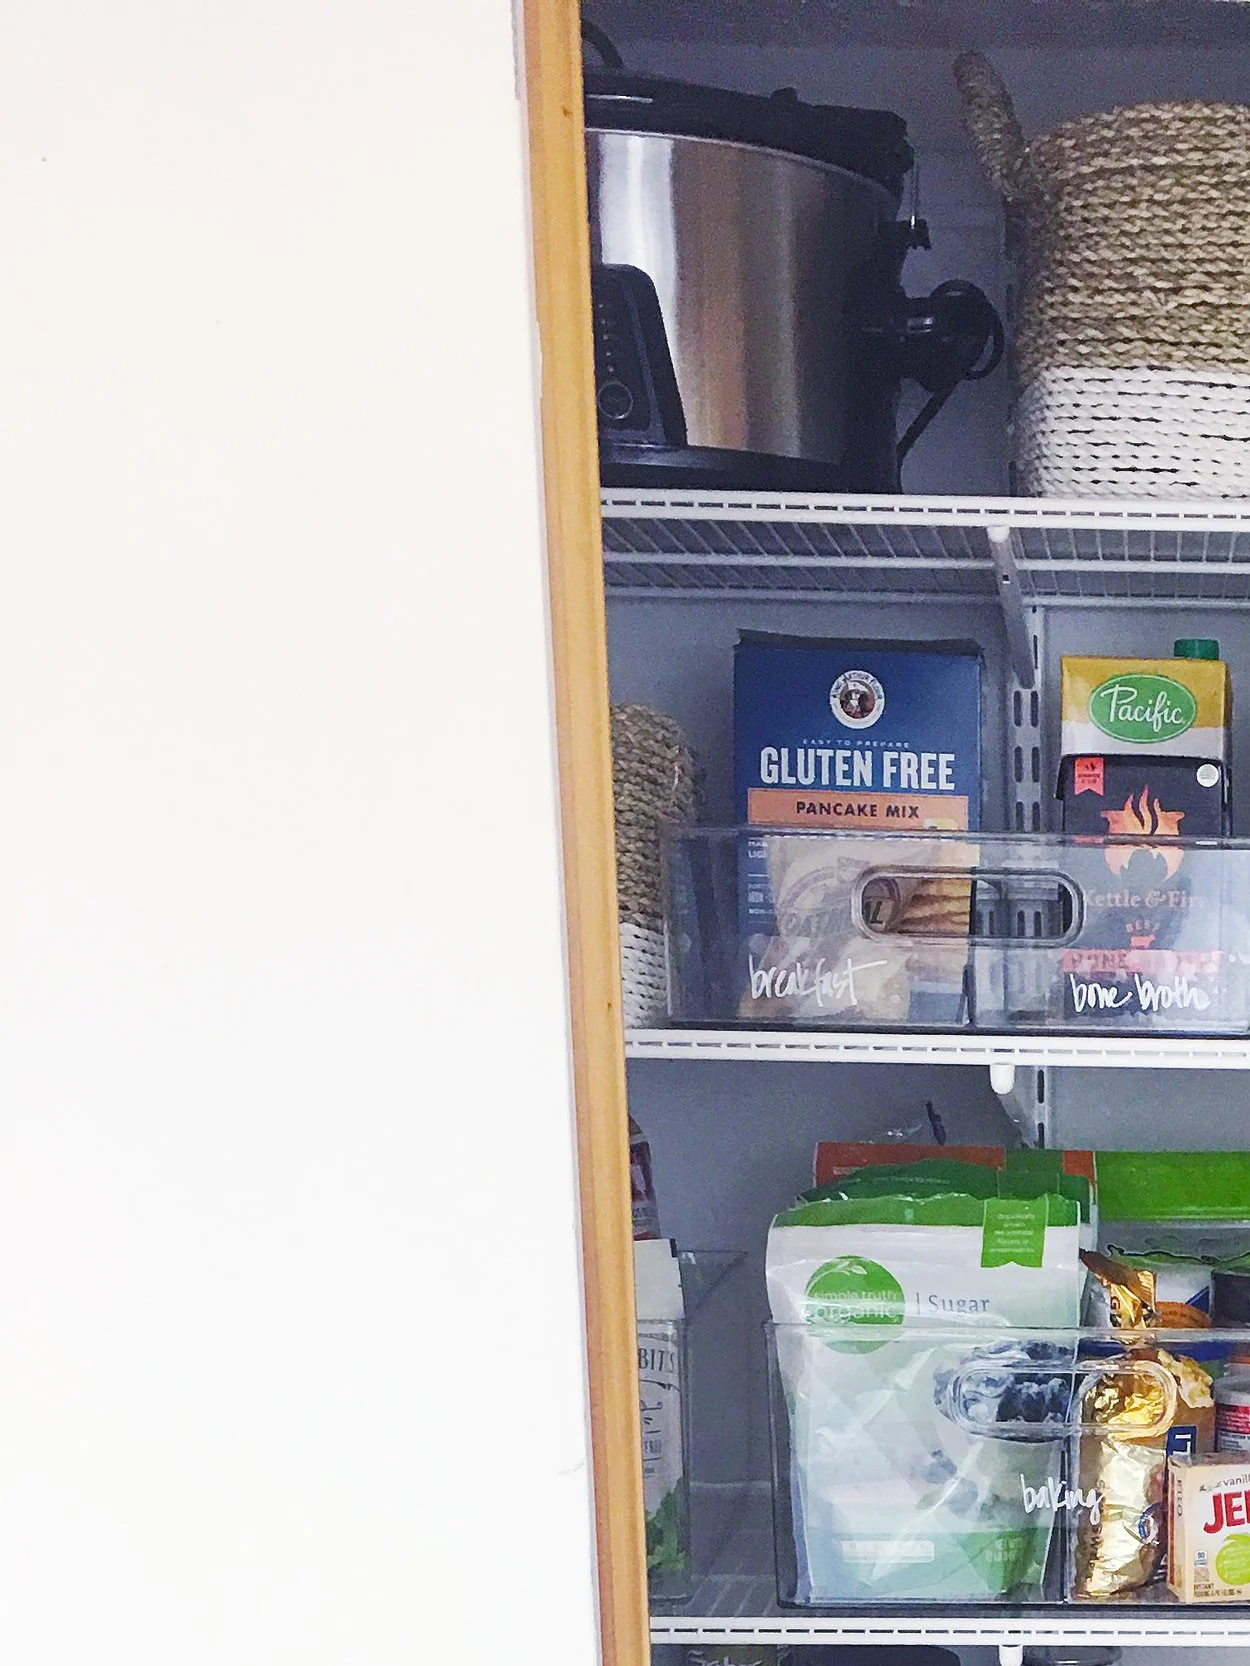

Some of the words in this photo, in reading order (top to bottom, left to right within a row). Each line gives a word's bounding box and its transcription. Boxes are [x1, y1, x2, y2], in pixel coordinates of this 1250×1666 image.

[1100, 684, 1183, 733] Pacific
[802, 738, 830, 747] EASY
[856, 740, 910, 749] PREPARE
[760, 746, 873, 787] GLUTEN
[883, 750, 956, 791] FREE
[796, 801, 878, 818] PANCAKE
[885, 803, 920, 819] MIX
[749, 954, 888, 1008] breakfast
[1069, 972, 1133, 1013] bone
[1134, 971, 1212, 1013] broth
[928, 1293, 991, 1313] Sugar
[1020, 1473, 1104, 1526] baking
